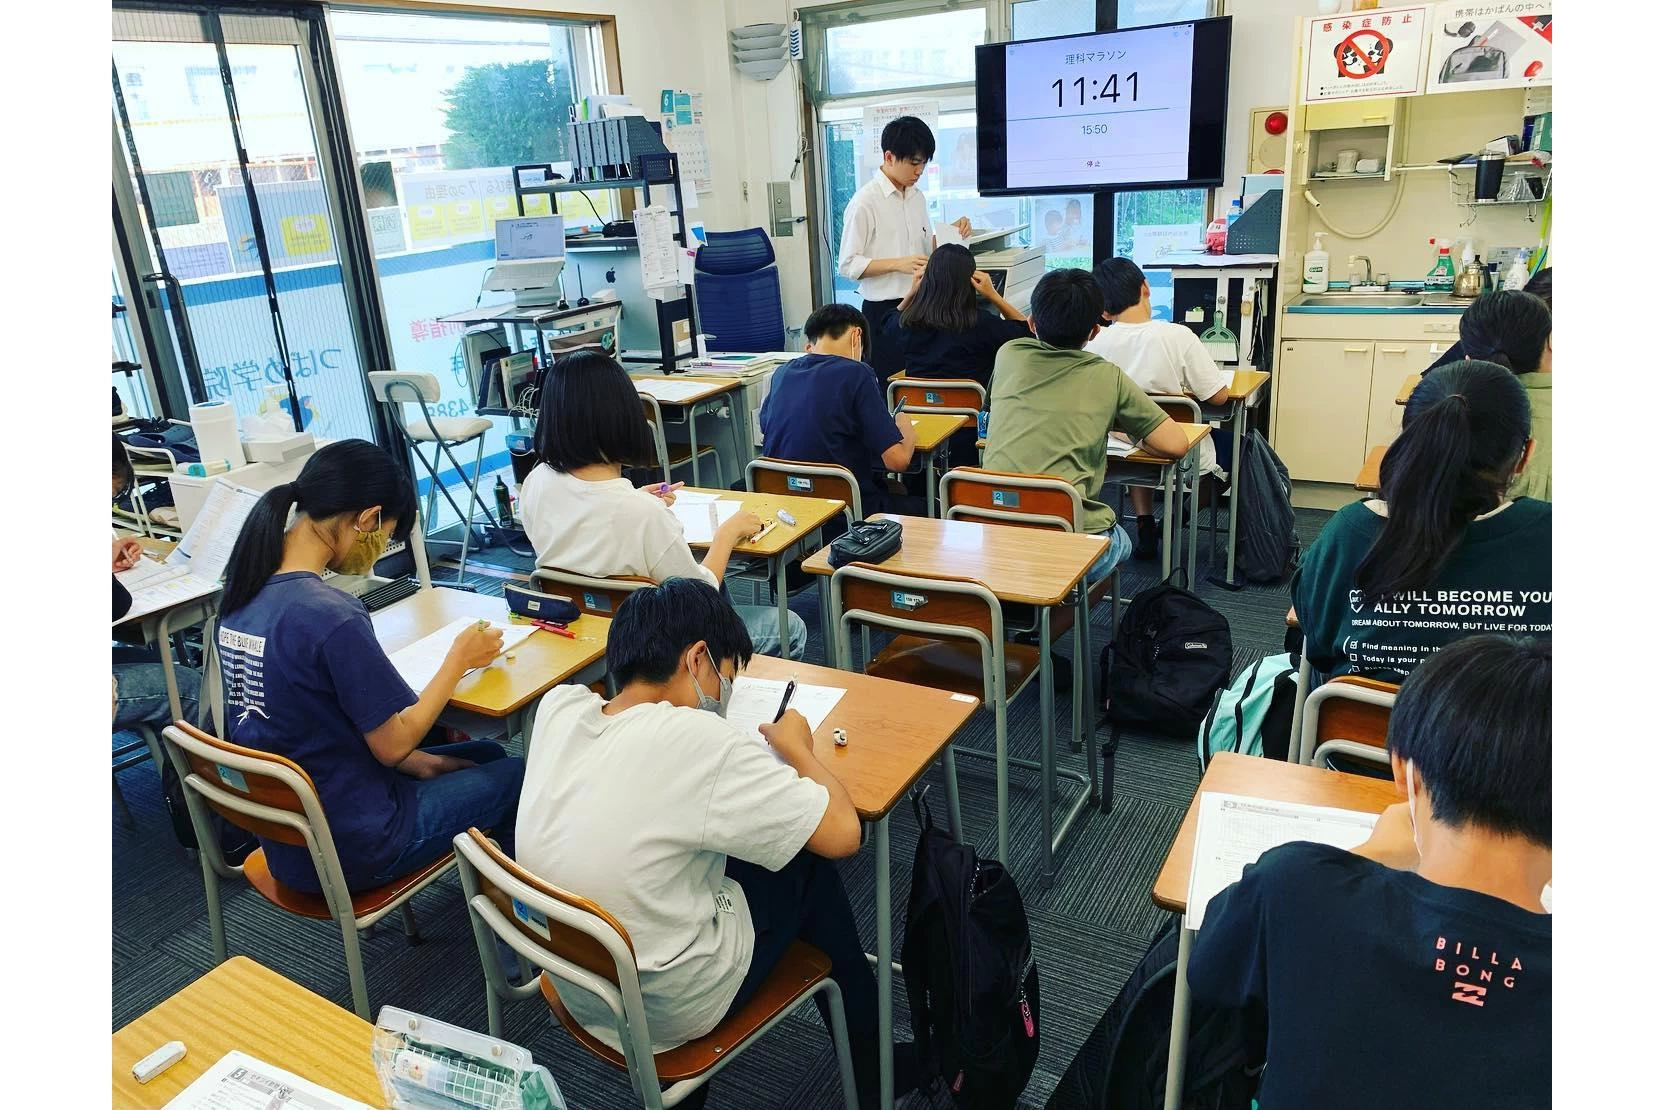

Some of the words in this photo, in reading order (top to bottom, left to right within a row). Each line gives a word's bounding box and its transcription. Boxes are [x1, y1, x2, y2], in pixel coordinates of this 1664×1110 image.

[1323, 14, 1412, 32] 感染症防止
[1065, 49, 1127, 65] 理科マラソン
[1051, 71, 1139, 108] 11:41
[1081, 124, 1108, 135] 15:50
[1086, 159, 1101, 168] 停止
[1437, 590, 1513, 603] BECOME
[1373, 603, 1411, 614] ALLY
[1417, 603, 1526, 617] TOMORROW
[1372, 620, 1401, 628] ABOUT
[1402, 620, 1460, 630] TOMORROW,
[1462, 622, 1482, 630] BUT
[1484, 623, 1506, 631] LIVE
[1508, 624, 1527, 632] FOR
[1362, 642, 1379, 650] Find
[1381, 645, 1418, 653] meaning
[1362, 655, 1385, 664] Today
[1435, 935, 1522, 970] BILLA
[1435, 958, 1515, 988] BONG
